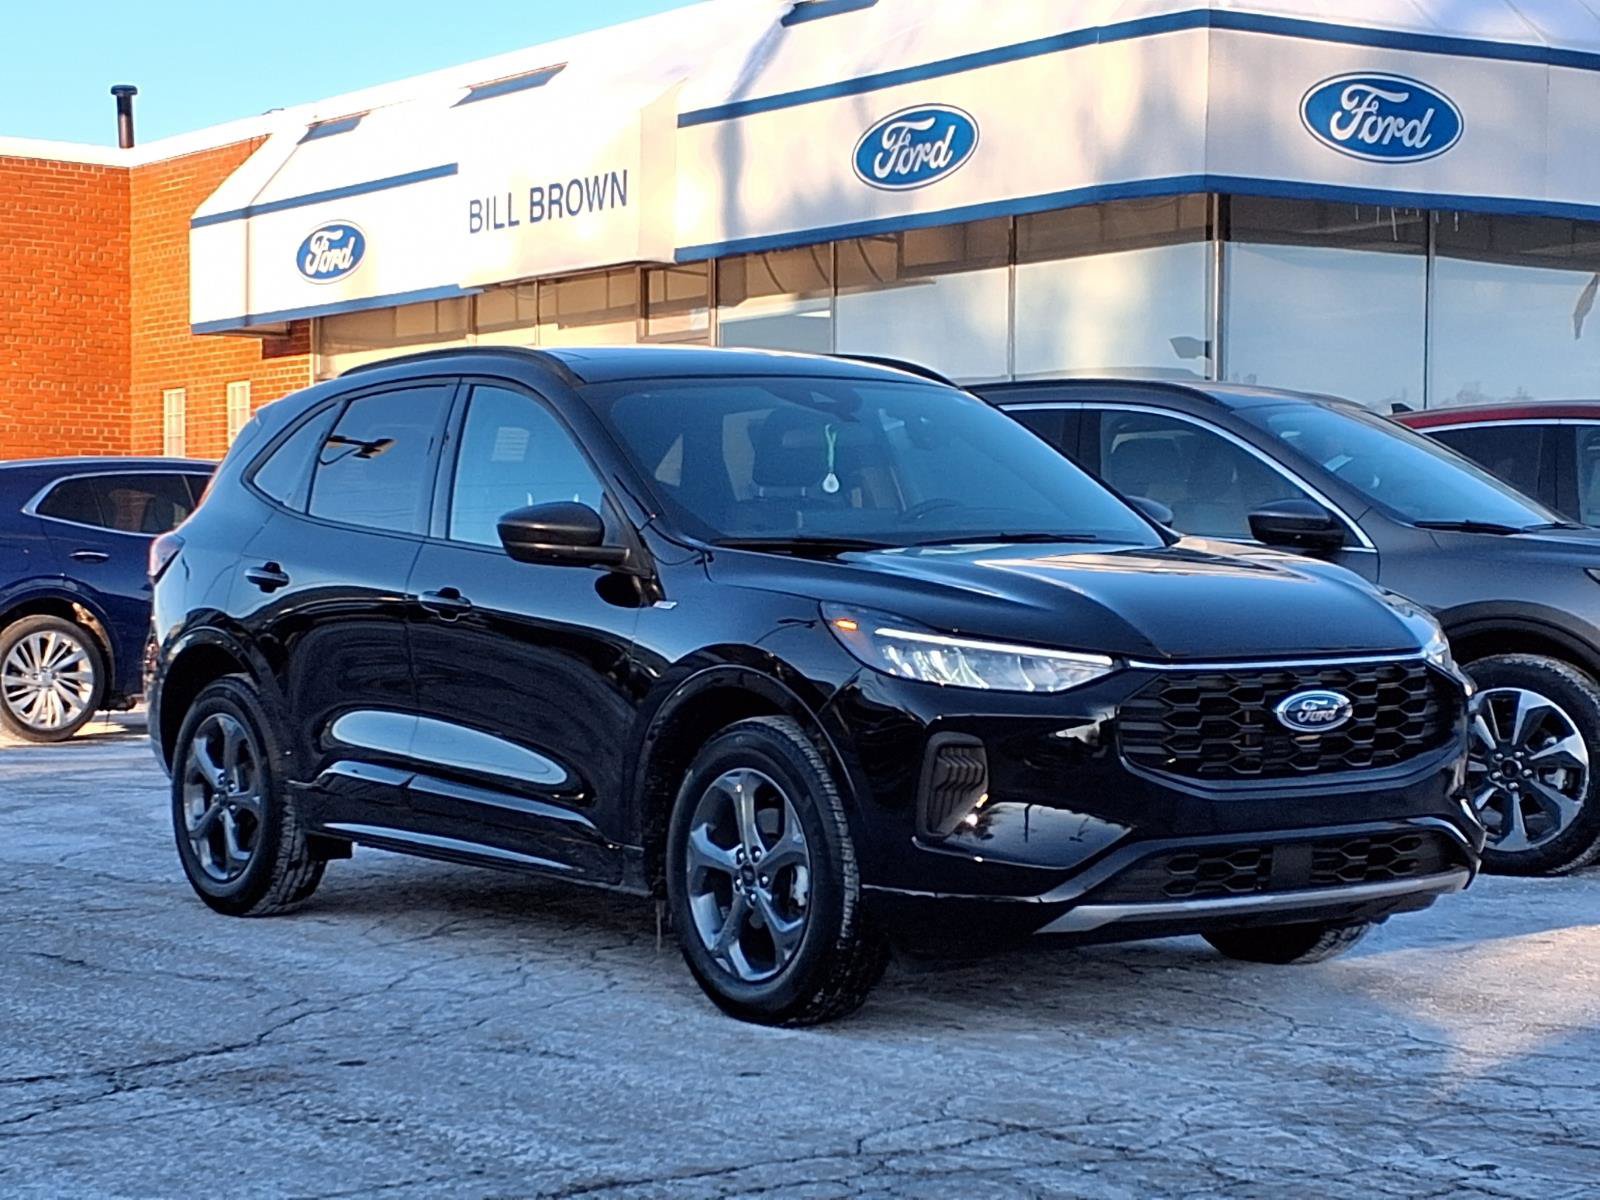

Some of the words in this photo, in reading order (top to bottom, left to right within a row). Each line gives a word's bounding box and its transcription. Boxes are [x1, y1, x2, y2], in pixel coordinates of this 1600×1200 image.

[1330, 84, 1435, 149] Ford
[873, 117, 956, 179] Ford
[469, 192, 520, 234] BILL
[529, 169, 628, 223] BROWN
[305, 229, 356, 275] Ford
[1297, 699, 1338, 723] Ford
